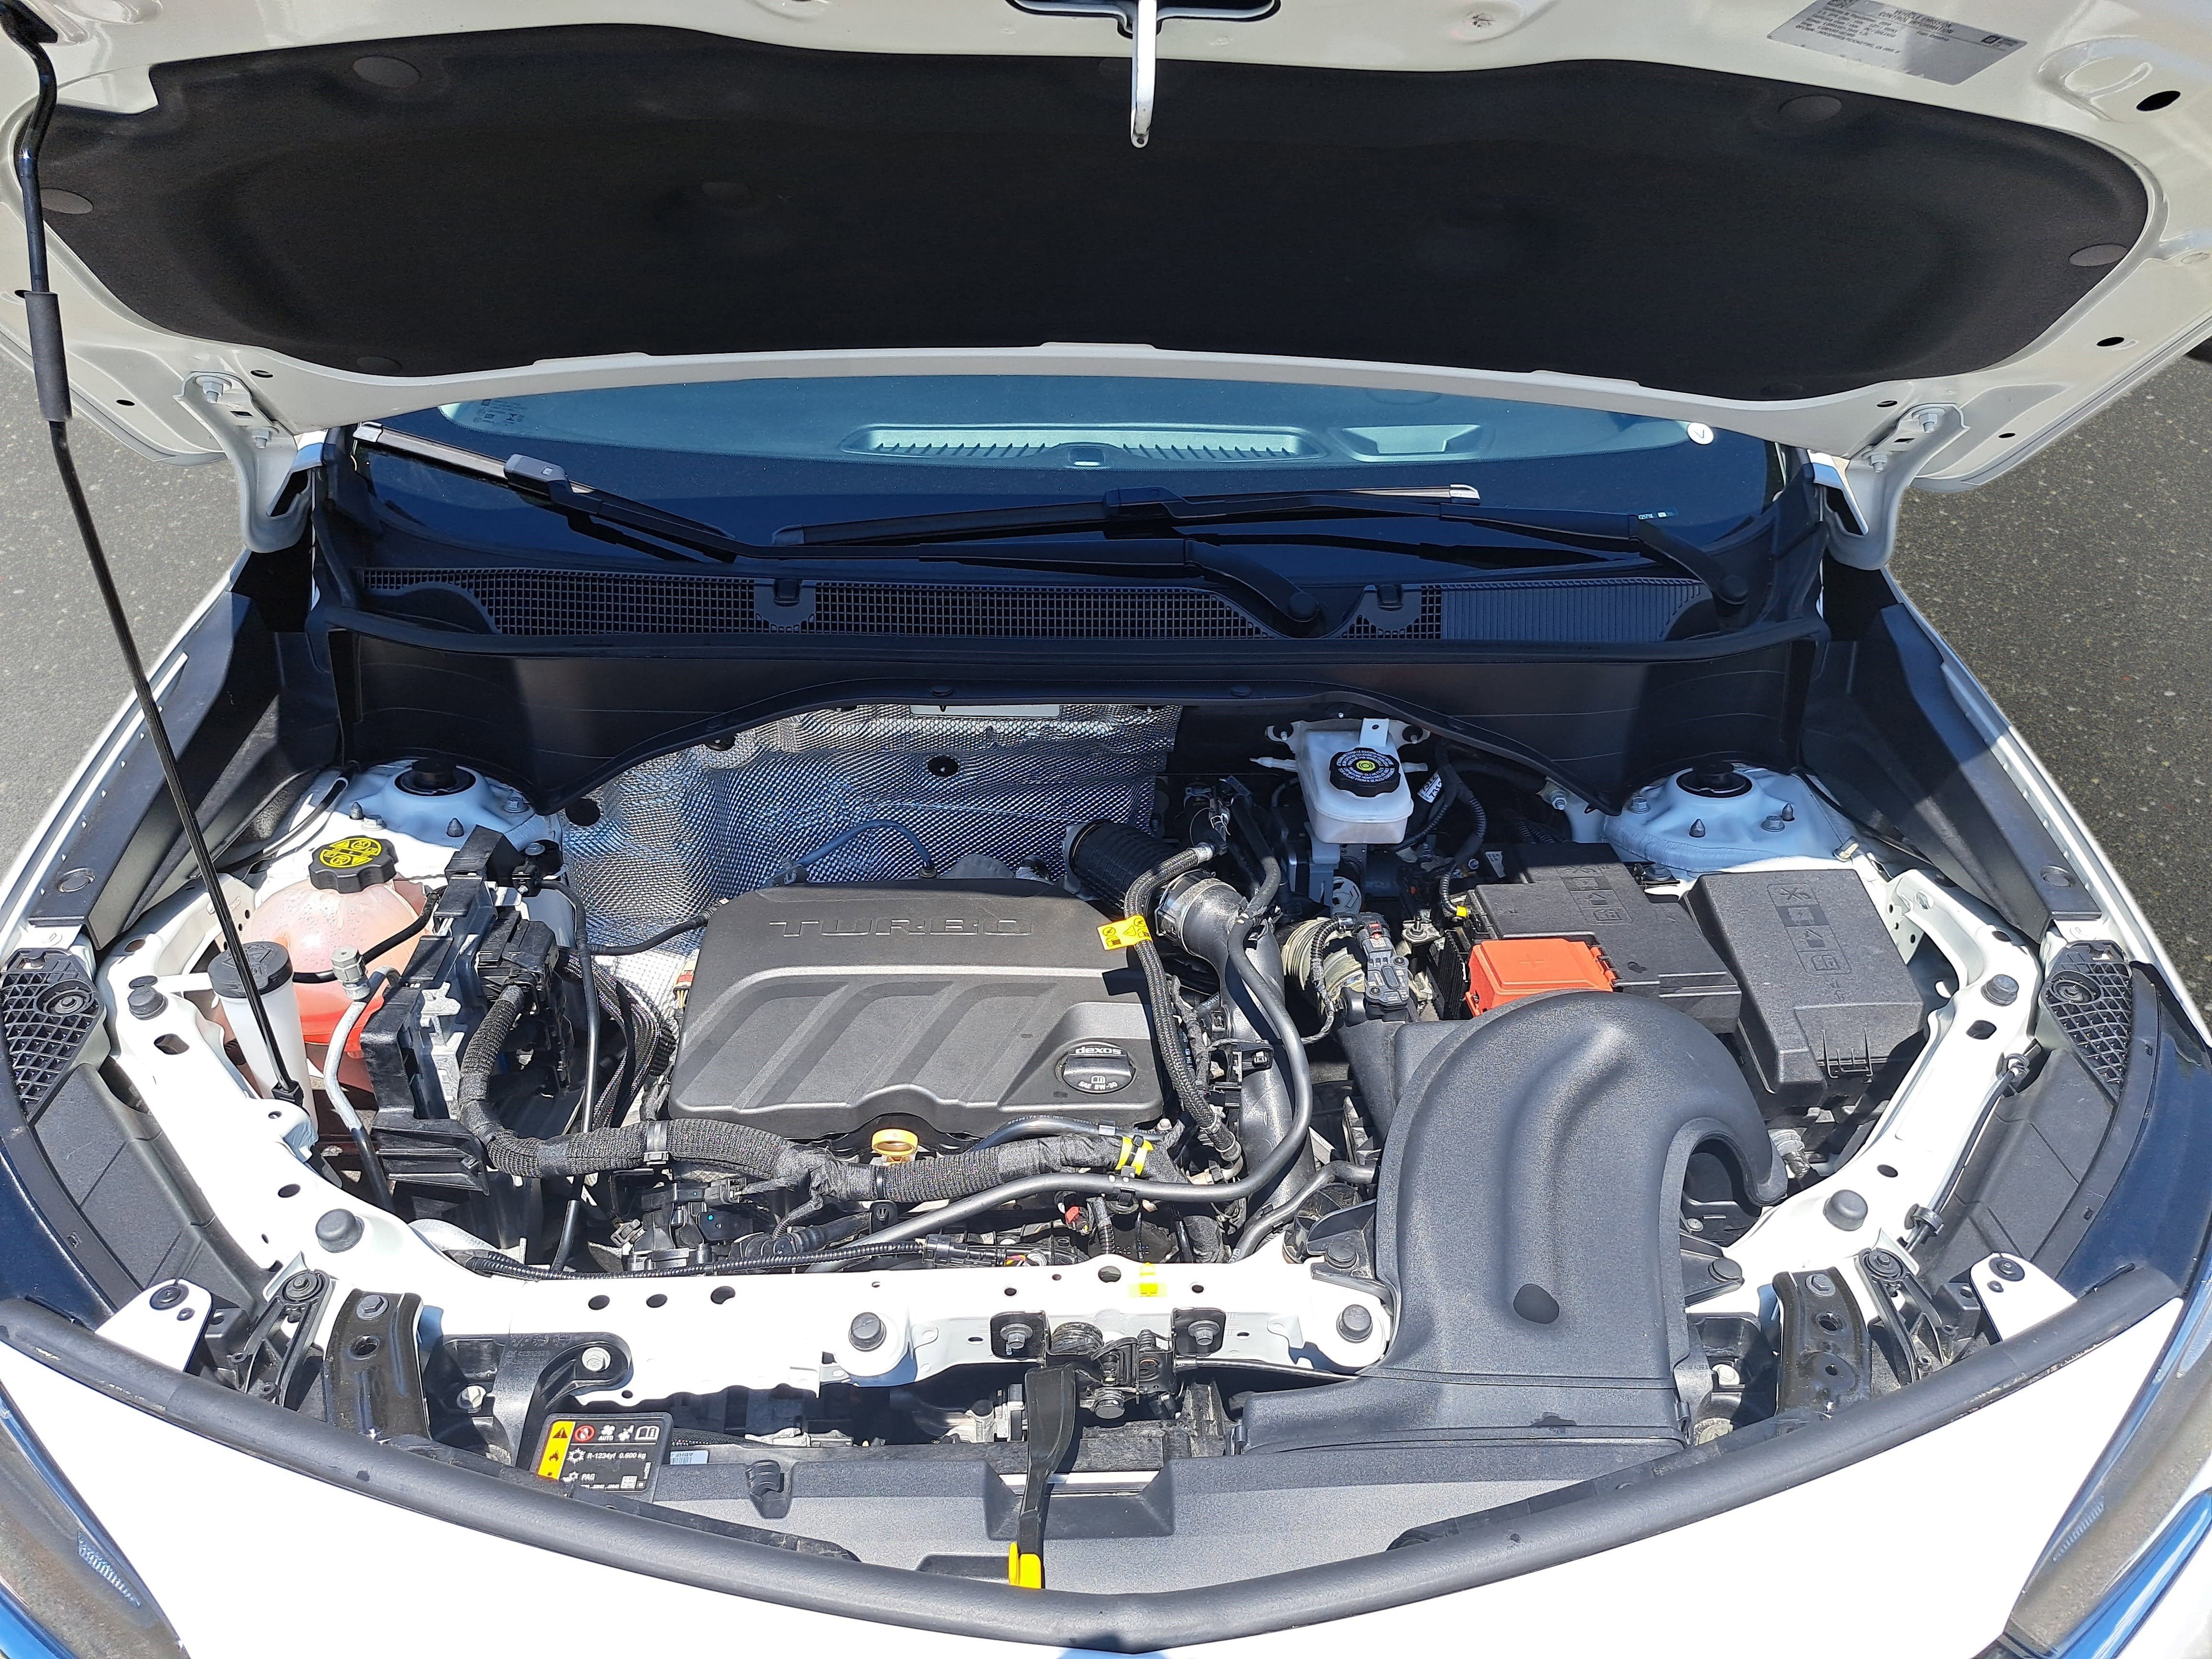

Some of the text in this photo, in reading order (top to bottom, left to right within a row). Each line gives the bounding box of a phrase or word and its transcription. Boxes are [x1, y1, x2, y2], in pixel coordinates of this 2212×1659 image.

[769, 918, 1031, 937] TURBO
[1094, 1082, 1118, 1090] 5W-30
[581, 1473, 596, 1482] PAG
